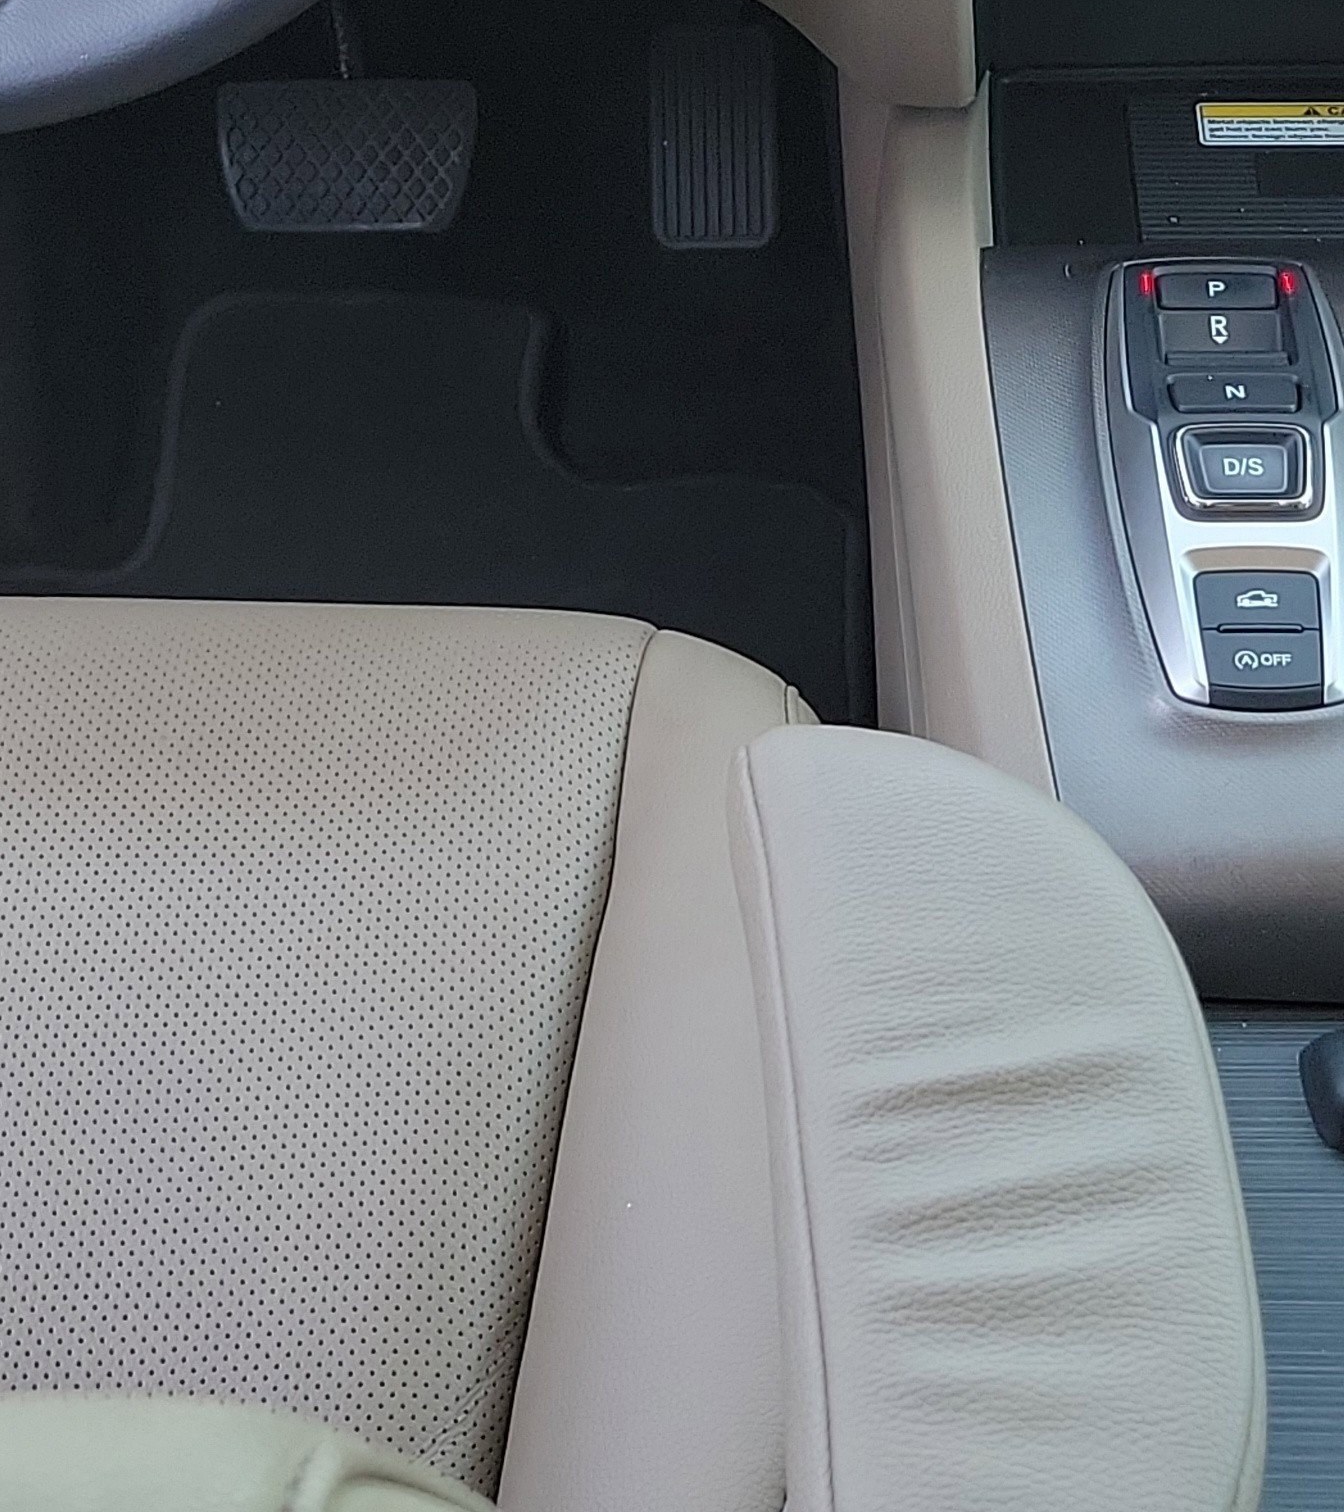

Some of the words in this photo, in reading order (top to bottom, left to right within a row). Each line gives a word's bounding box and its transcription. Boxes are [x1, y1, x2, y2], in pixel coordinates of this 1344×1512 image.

[1208, 281, 1226, 297] P
[1210, 316, 1228, 336] R
[1225, 385, 1246, 399] N
[1223, 458, 1265, 476] D/S
[1260, 653, 1292, 667] OFF
